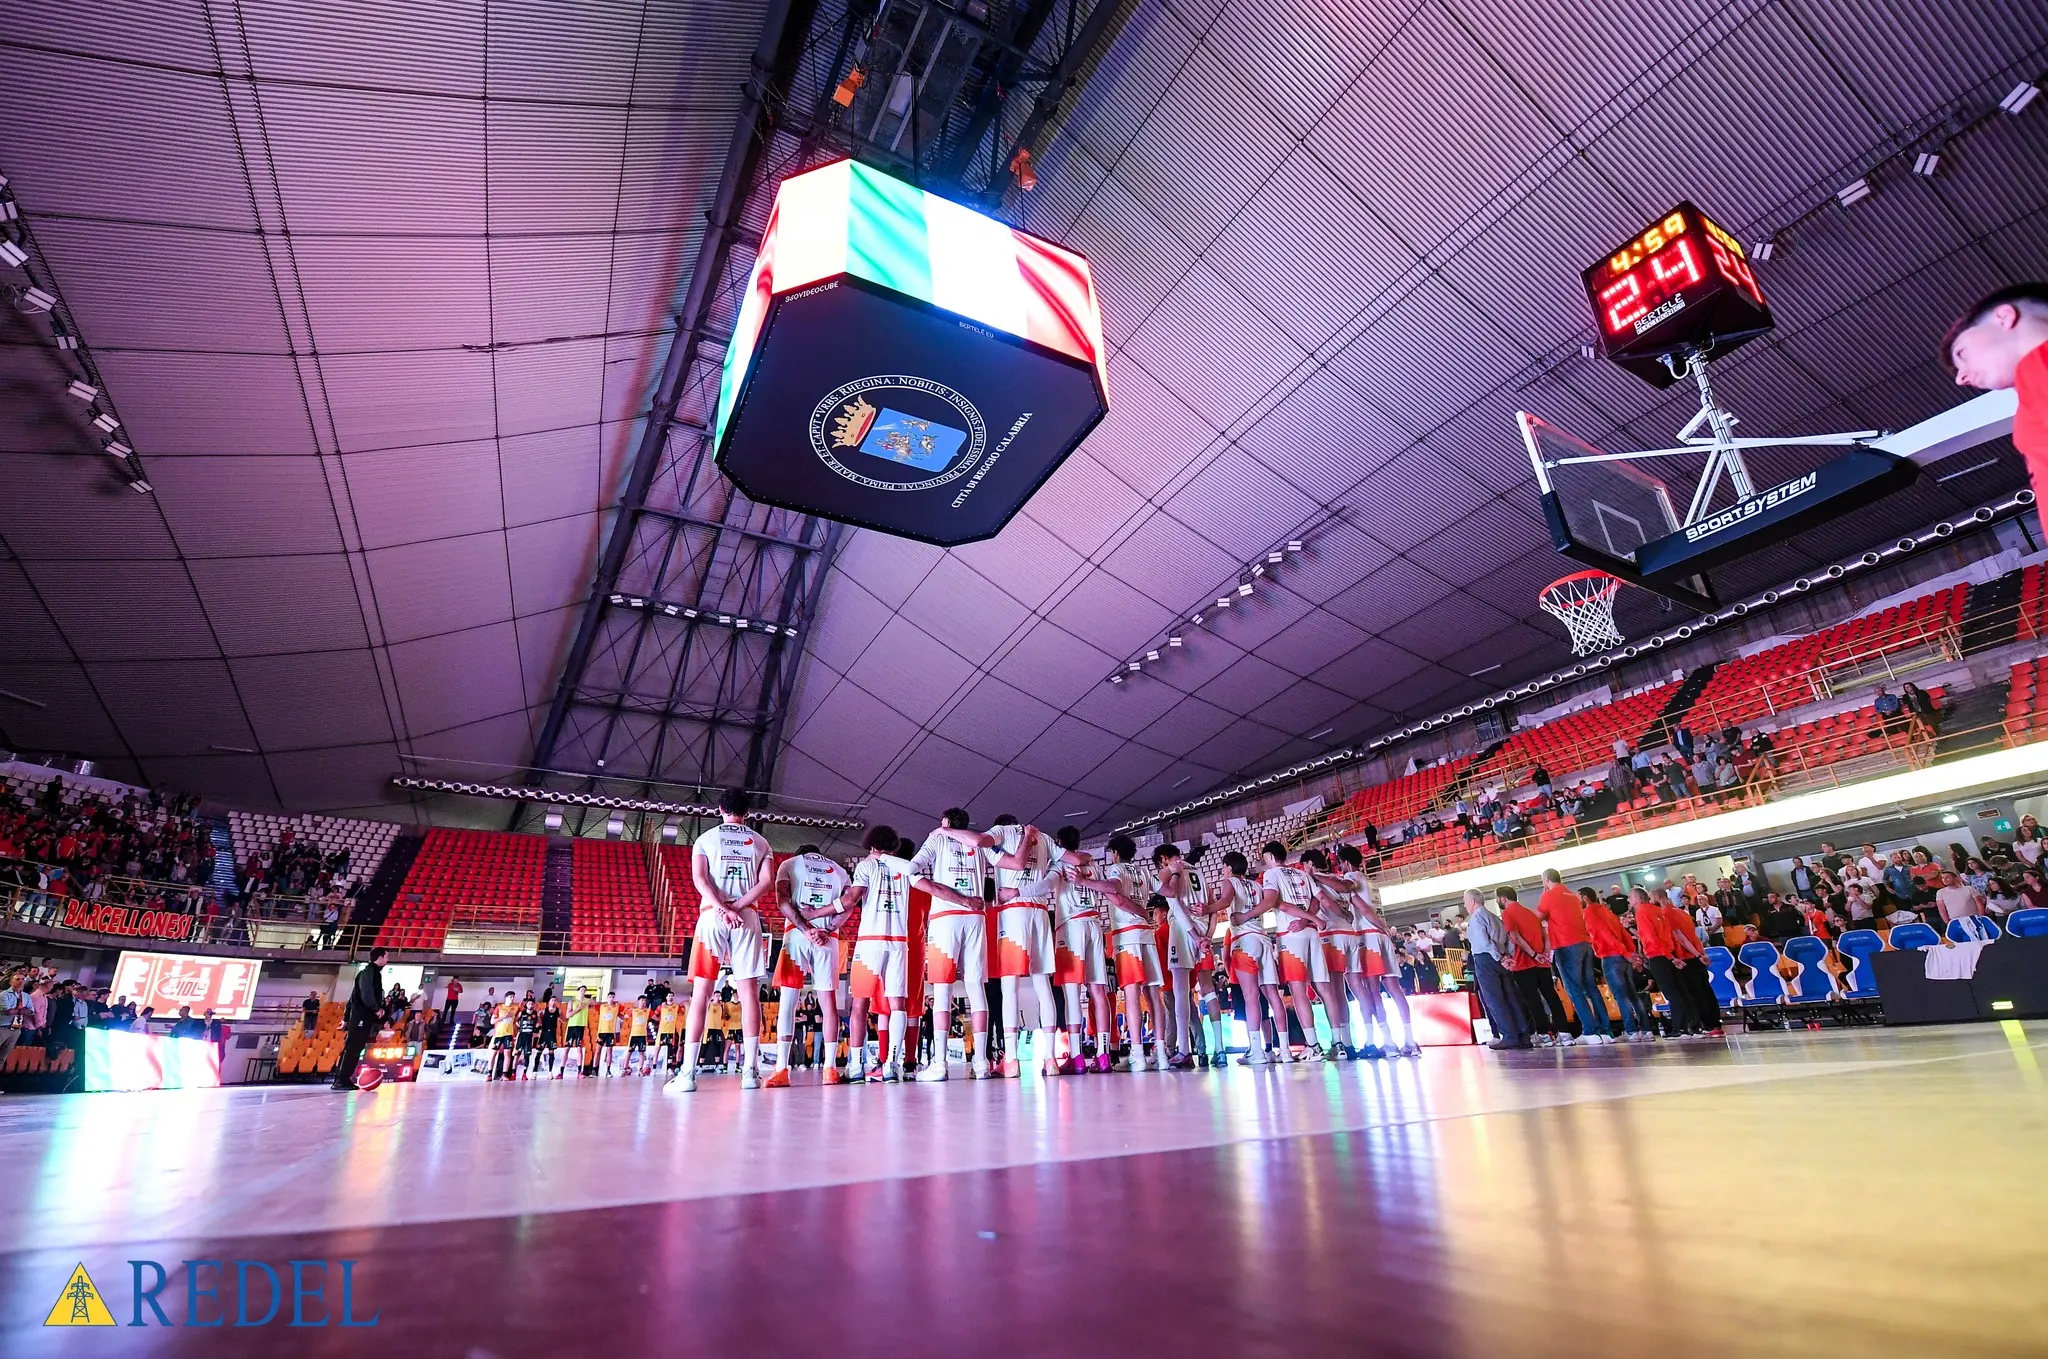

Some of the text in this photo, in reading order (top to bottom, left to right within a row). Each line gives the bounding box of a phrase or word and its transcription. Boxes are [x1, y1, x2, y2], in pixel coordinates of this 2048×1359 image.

[1610, 211, 1687, 272] 4:59
[1602, 240, 1700, 331] 24
[899, 377, 948, 397] NOBILIS:
[951, 412, 1033, 508] CITTÀ DI REGGIO CALABRIA
[1189, 872, 1202, 891] 9
[64, 899, 194, 940] BARCELLONESI
[1171, 946, 1176, 956] 9
